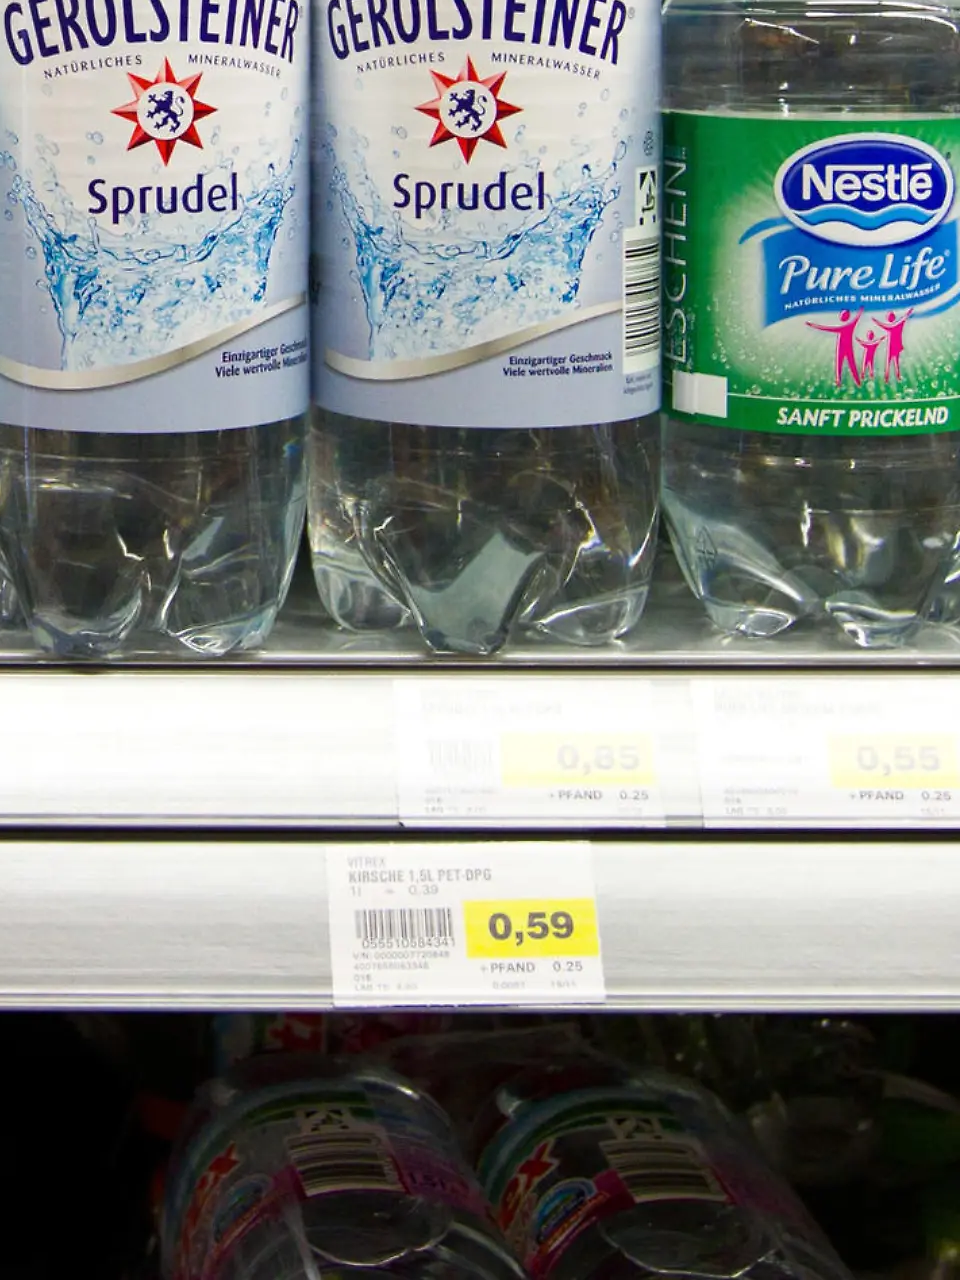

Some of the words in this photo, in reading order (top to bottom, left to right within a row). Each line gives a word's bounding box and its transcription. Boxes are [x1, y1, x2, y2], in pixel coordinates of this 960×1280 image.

[44, 54, 143, 80] NATÜRLICHES
[188, 53, 281, 79] MINERALWASSER
[356, 52, 446, 74] NATÜRLICHES
[490, 52, 601, 81] MINERALWASSER
[803, 163, 932, 202] Nestlé
[88, 173, 238, 224] Sprudel
[393, 172, 546, 219] Sprudel
[778, 255, 876, 295] Pure
[878, 247, 946, 289] Life
[784, 295, 857, 311] NATÜRLICHES
[860, 284, 941, 304] MINERALWASSER
[222, 347, 278, 364] Einzigartiger
[509, 354, 567, 368] Einzigartiger
[569, 351, 613, 363] Geschmack
[215, 365, 240, 378] Viele
[242, 359, 281, 375] wertvolle
[502, 366, 526, 377] Viele
[528, 365, 570, 376] wertvolle
[572, 363, 614, 375] Mineralien
[777, 407, 842, 427] SANFT
[847, 407, 949, 428] PRICKELND
[556, 743, 640, 774] 0,85
[856, 745, 941, 777] 0,55
[557, 790, 603, 800] PFAND
[619, 789, 649, 800] 0.25
[859, 790, 904, 801] PFAND
[921, 790, 952, 801] 0.25
[347, 857, 386, 868] VITREX
[348, 870, 404, 883] KIRSCHE
[409, 869, 435, 883] 1,5L
[408, 884, 440, 896] 0.39
[488, 911, 575, 946] 0,59
[490, 962, 536, 973] PFAND
[553, 961, 583, 972] 0.25
